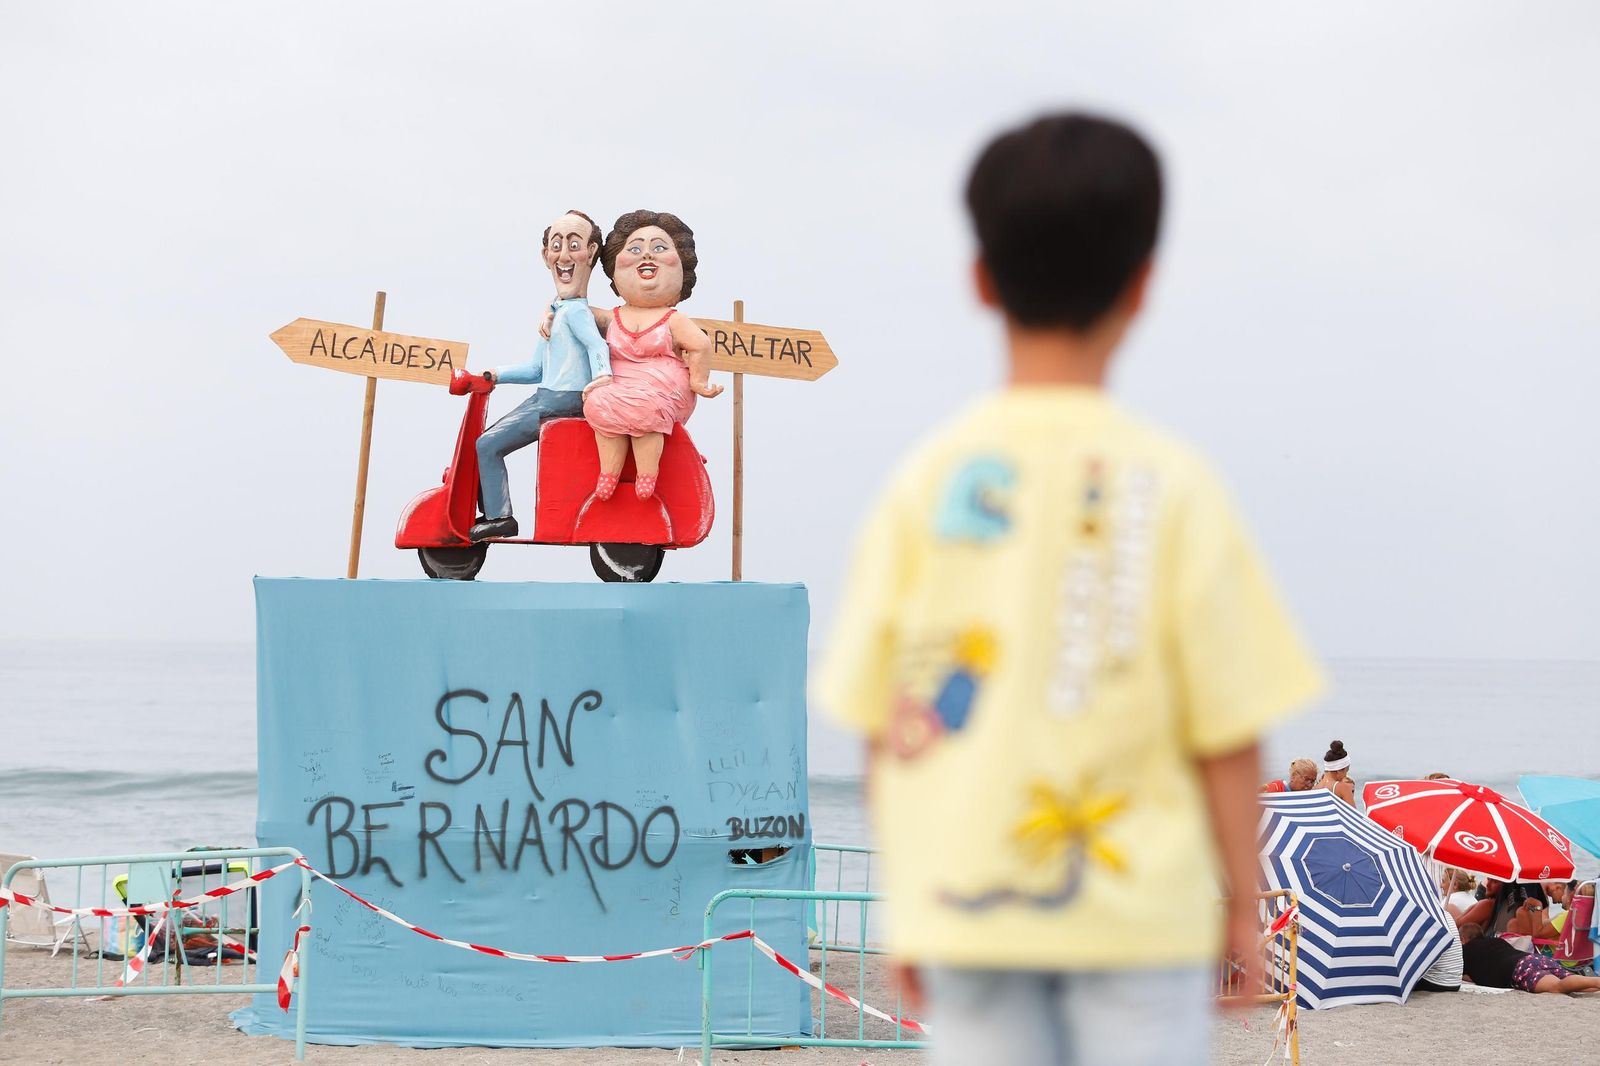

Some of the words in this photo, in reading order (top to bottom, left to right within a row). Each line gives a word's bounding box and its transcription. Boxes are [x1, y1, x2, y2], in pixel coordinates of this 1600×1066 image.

[701, 328, 812, 368] RALTAR
[424, 689, 603, 801] SAN
[293, 796, 681, 914] BERNARDO
[726, 812, 805, 841] BUZON
